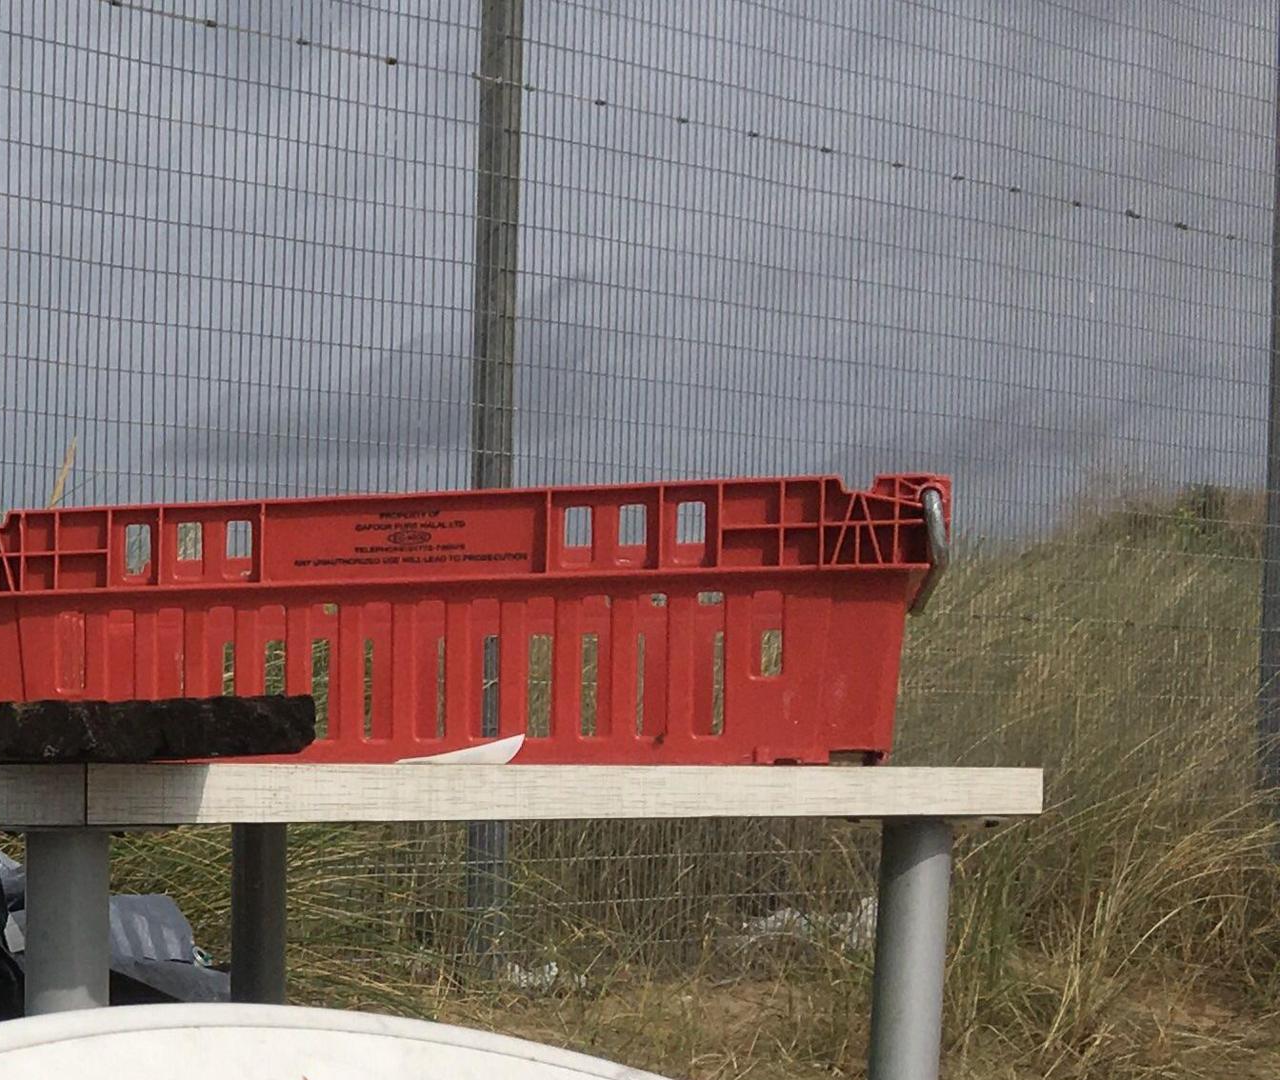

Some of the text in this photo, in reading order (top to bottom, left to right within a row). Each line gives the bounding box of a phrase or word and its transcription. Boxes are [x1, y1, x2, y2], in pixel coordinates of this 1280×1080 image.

[419, 520, 446, 530] HALAL
[422, 553, 446, 564] LEAD
[448, 553, 461, 562] TO
